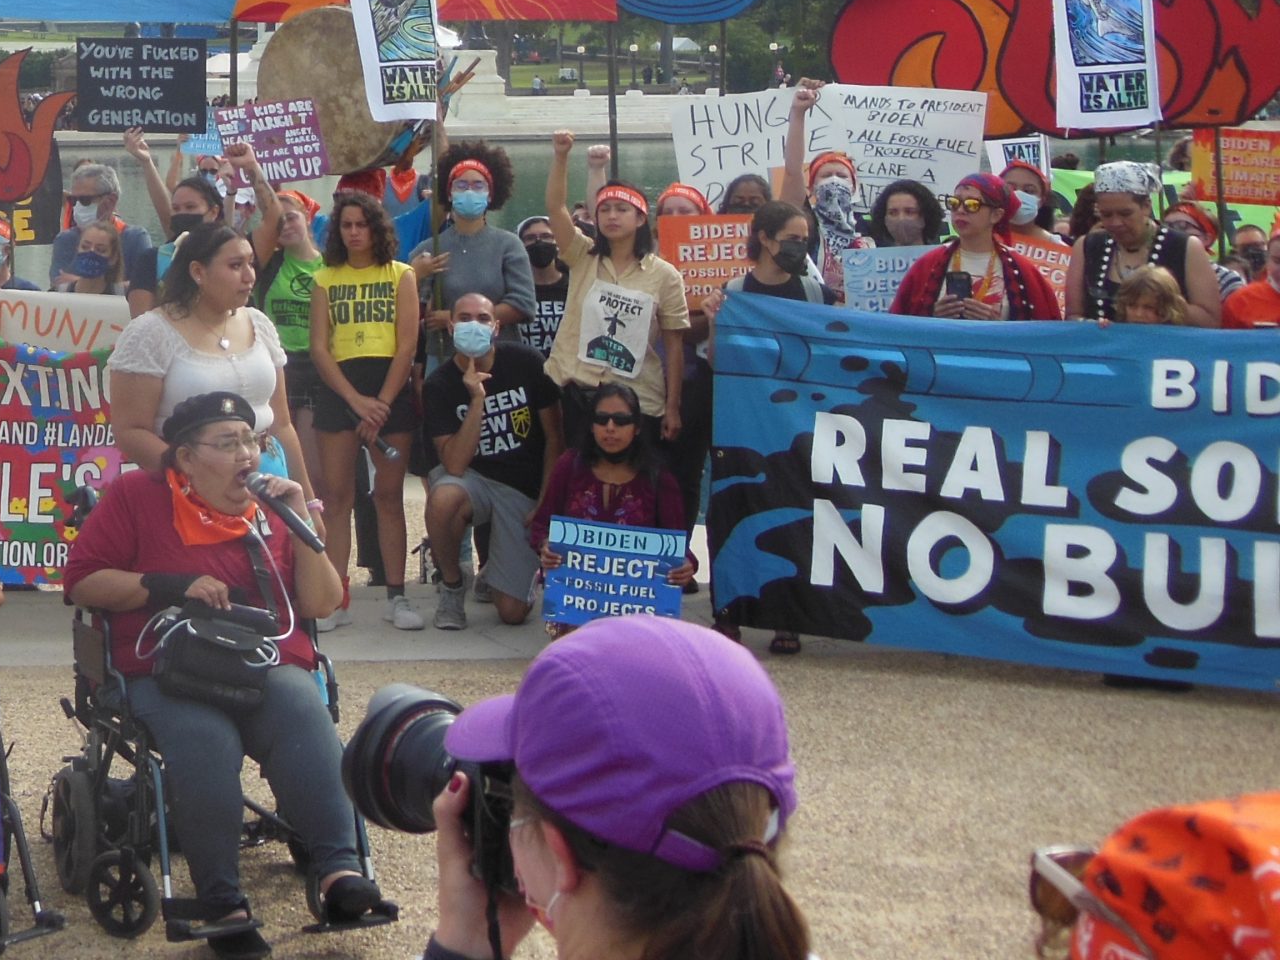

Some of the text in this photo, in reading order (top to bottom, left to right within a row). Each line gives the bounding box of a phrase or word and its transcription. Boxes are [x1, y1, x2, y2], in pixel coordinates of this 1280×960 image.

[142, 44, 199, 61] FUCKED
[90, 66, 174, 79] WITH THE
[383, 66, 436, 85] WATER
[387, 85, 407, 100] IS
[1082, 74, 1146, 92] WATER
[840, 93, 891, 110] MANDS
[920, 99, 983, 113] PRESIDENT
[1083, 89, 1147, 108] IS ALIVE
[88, 109, 197, 126] GENERATION
[218, 108, 247, 121] THE
[254, 102, 285, 117] KIDS
[288, 100, 313, 113] ARE
[690, 91, 833, 139] HUNGR
[867, 110, 926, 127] BIDEN
[218, 121, 239, 135] NOT
[273, 148, 290, 157] ARE
[293, 143, 320, 155] NOT
[690, 126, 833, 177] STRIE
[856, 129, 882, 141] ALL
[888, 132, 928, 147] FOSSIL
[935, 139, 977, 155] FUEL
[864, 144, 933, 159] PROJECTS
[1220, 137, 1270, 151] BIDEN
[299, 156, 322, 176] UP
[856, 162, 936, 183] CLARE A
[690, 223, 749, 240] BIDEN
[679, 243, 748, 262] REJEC
[681, 268, 727, 278] FOSSIL
[329, 282, 394, 302] OUR TIME
[330, 301, 350, 325] TO
[353, 299, 395, 323] RISE
[599, 295, 643, 316] PROTECT
[811, 411, 1069, 508] REAL
[583, 529, 648, 550] BIDEN
[810, 498, 995, 605] NO
[566, 550, 659, 579] REJECT
[565, 576, 656, 599] FOSSIL FUEL
[563, 594, 656, 617] PROJECTS
